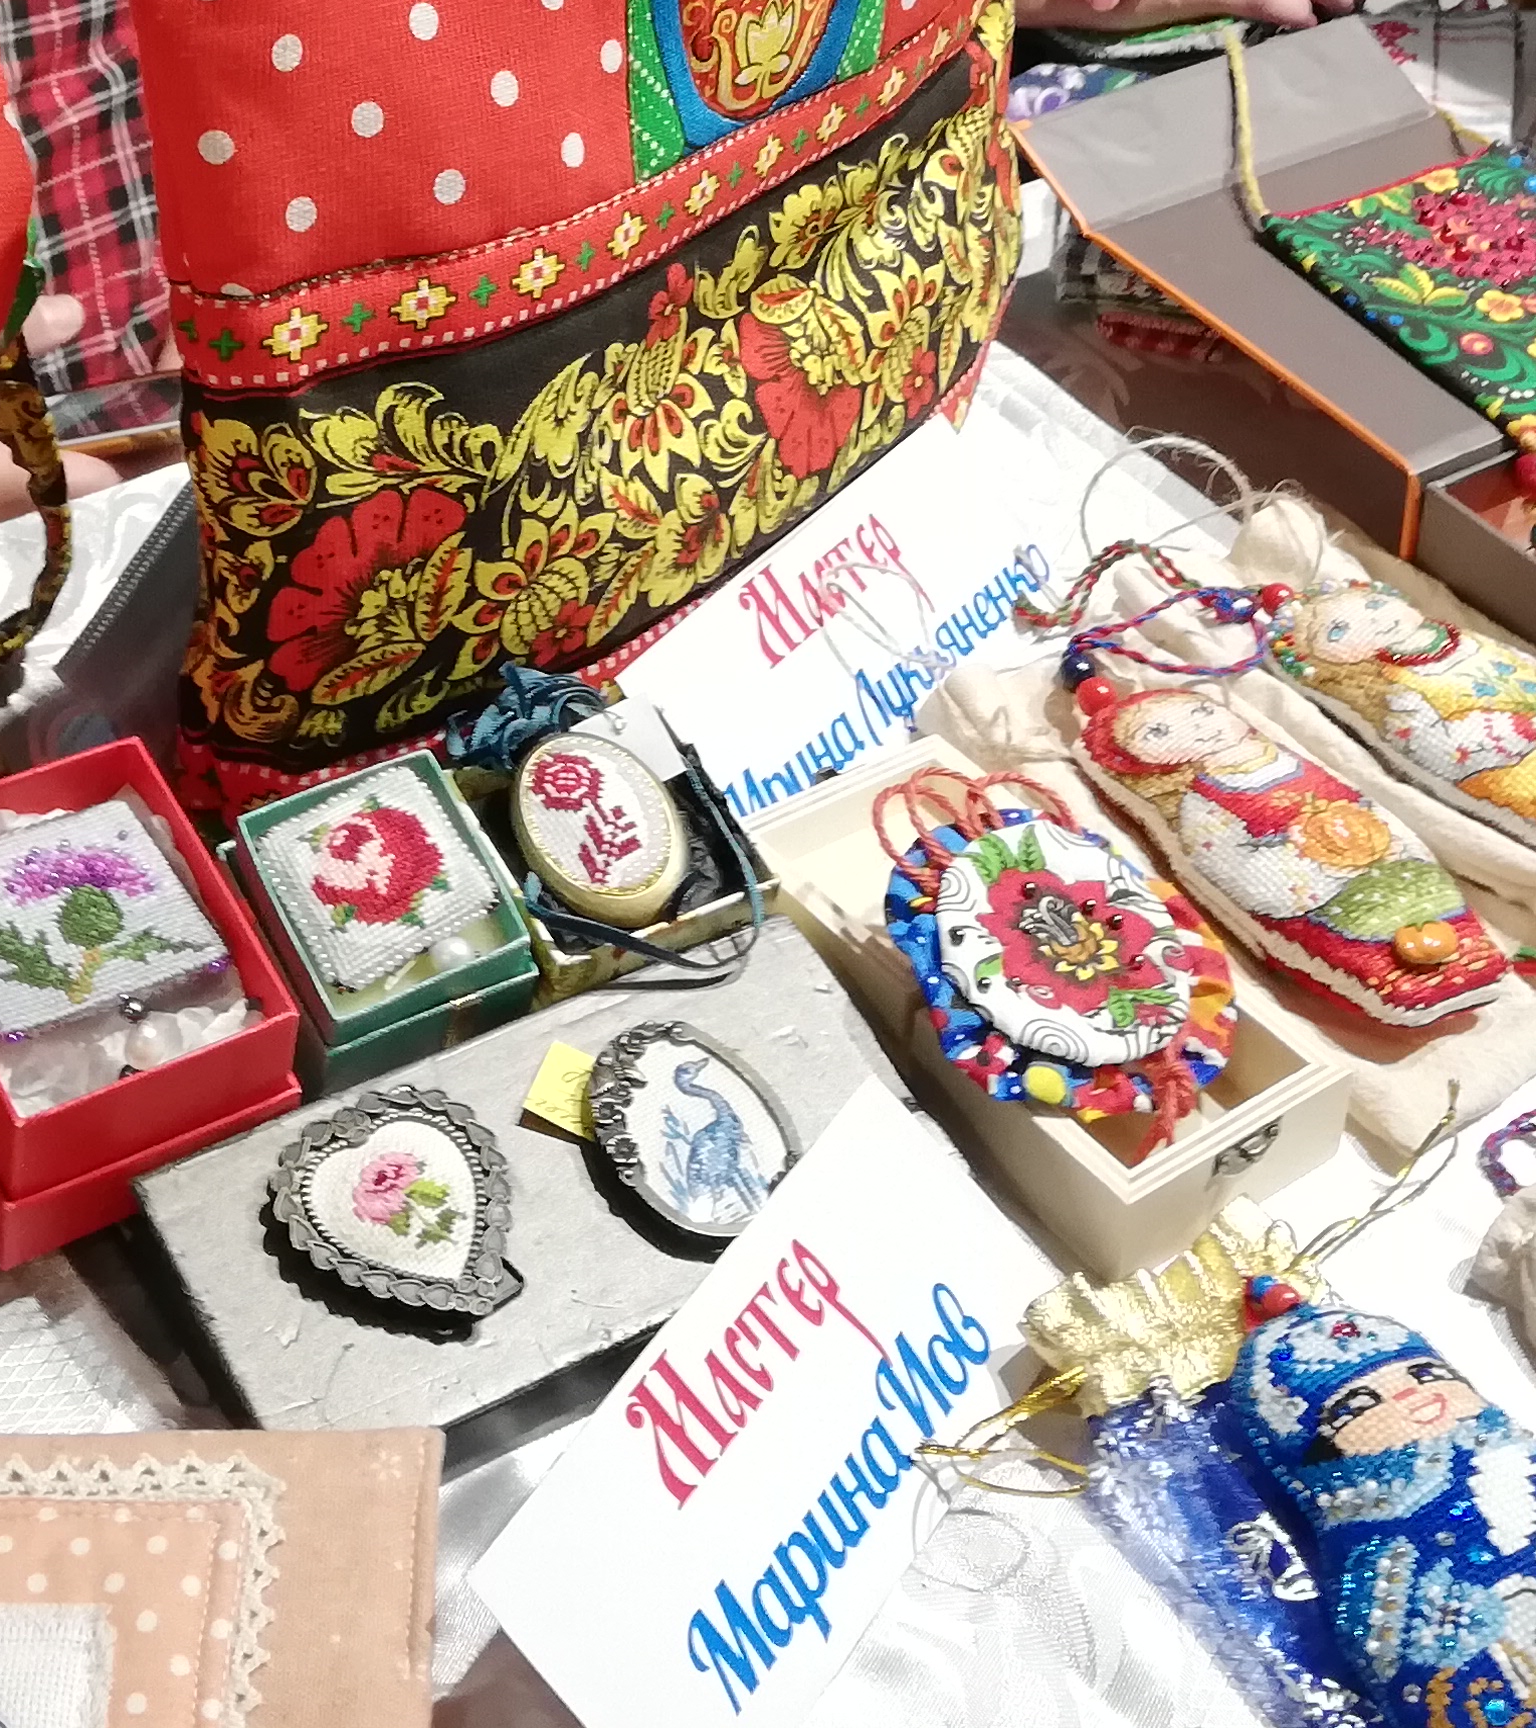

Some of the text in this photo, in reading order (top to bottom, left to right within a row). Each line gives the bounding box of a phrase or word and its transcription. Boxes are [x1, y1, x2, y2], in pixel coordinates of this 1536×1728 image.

[738, 514, 936, 669] Мастер
[626, 1239, 893, 1510] Мастер
[687, 1283, 991, 1715] Марина Иов
